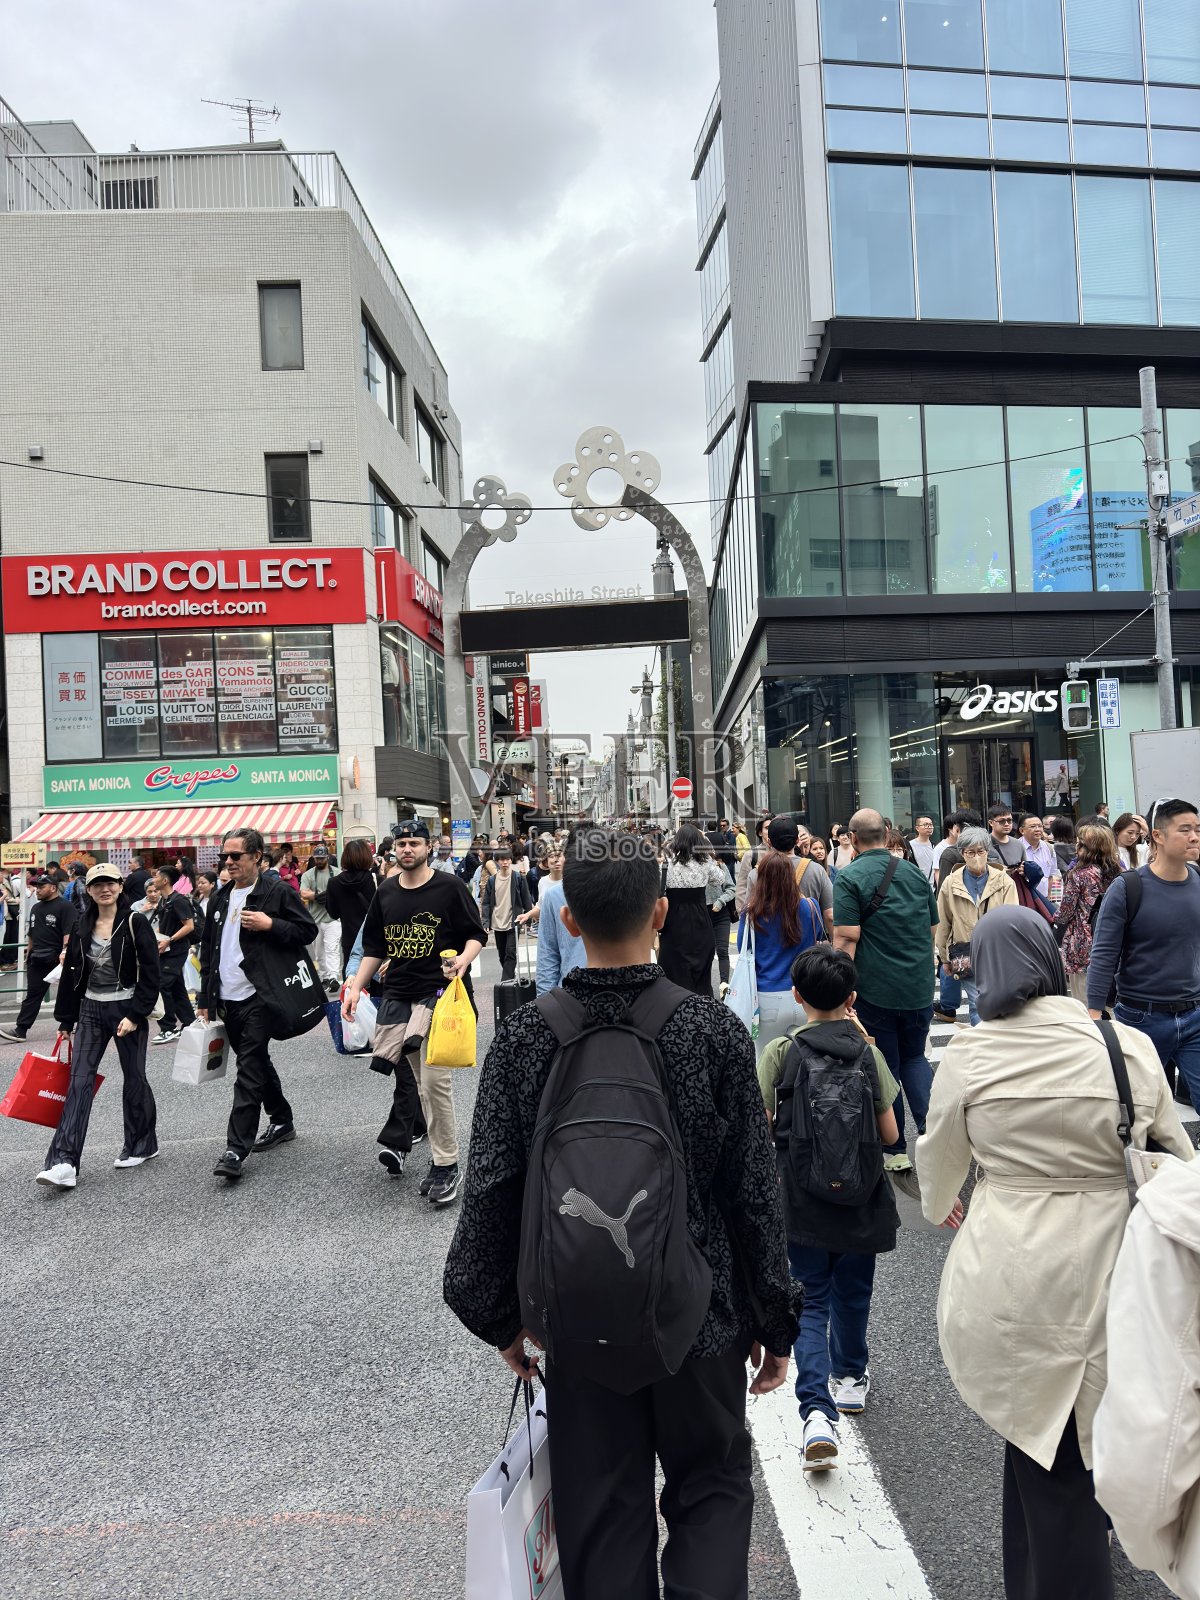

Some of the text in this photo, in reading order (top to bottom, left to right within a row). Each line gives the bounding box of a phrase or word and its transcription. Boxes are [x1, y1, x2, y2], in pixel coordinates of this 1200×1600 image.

[27, 562, 157, 596] BRAND
[505, 583, 642, 605] Takeshita Street
[101, 600, 267, 618] brandcollect.com
[58, 671, 86, 684] 高価
[105, 670, 153, 680] COMME
[161, 670, 182, 678] des
[185, 668, 212, 678] GAR
[188, 679, 213, 688] Yohji
[219, 677, 273, 686] Yamamoto
[59, 690, 87, 702] 買取
[123, 690, 155, 700] ISSEY
[163, 688, 205, 698] MIYAKE
[289, 685, 328, 695] GUCCI
[1099, 683, 1109, 708] 自転車
[119, 703, 214, 716] LOUIS VUITTON
[245, 702, 323, 712] SAINT LAURENT
[165, 715, 193, 723] CELINE
[220, 712, 274, 721] BALENCIAGA
[517, 695, 526, 735] ZETTERIA
[1105, 708, 1115, 725] 専用
[476, 686, 488, 760] BRAND COLLECT
[282, 726, 324, 735] CHANEL
[144, 765, 239, 797] Crepes
[251, 768, 330, 784] SANTA MONICA
[51, 776, 131, 793] SANTA MONICA
